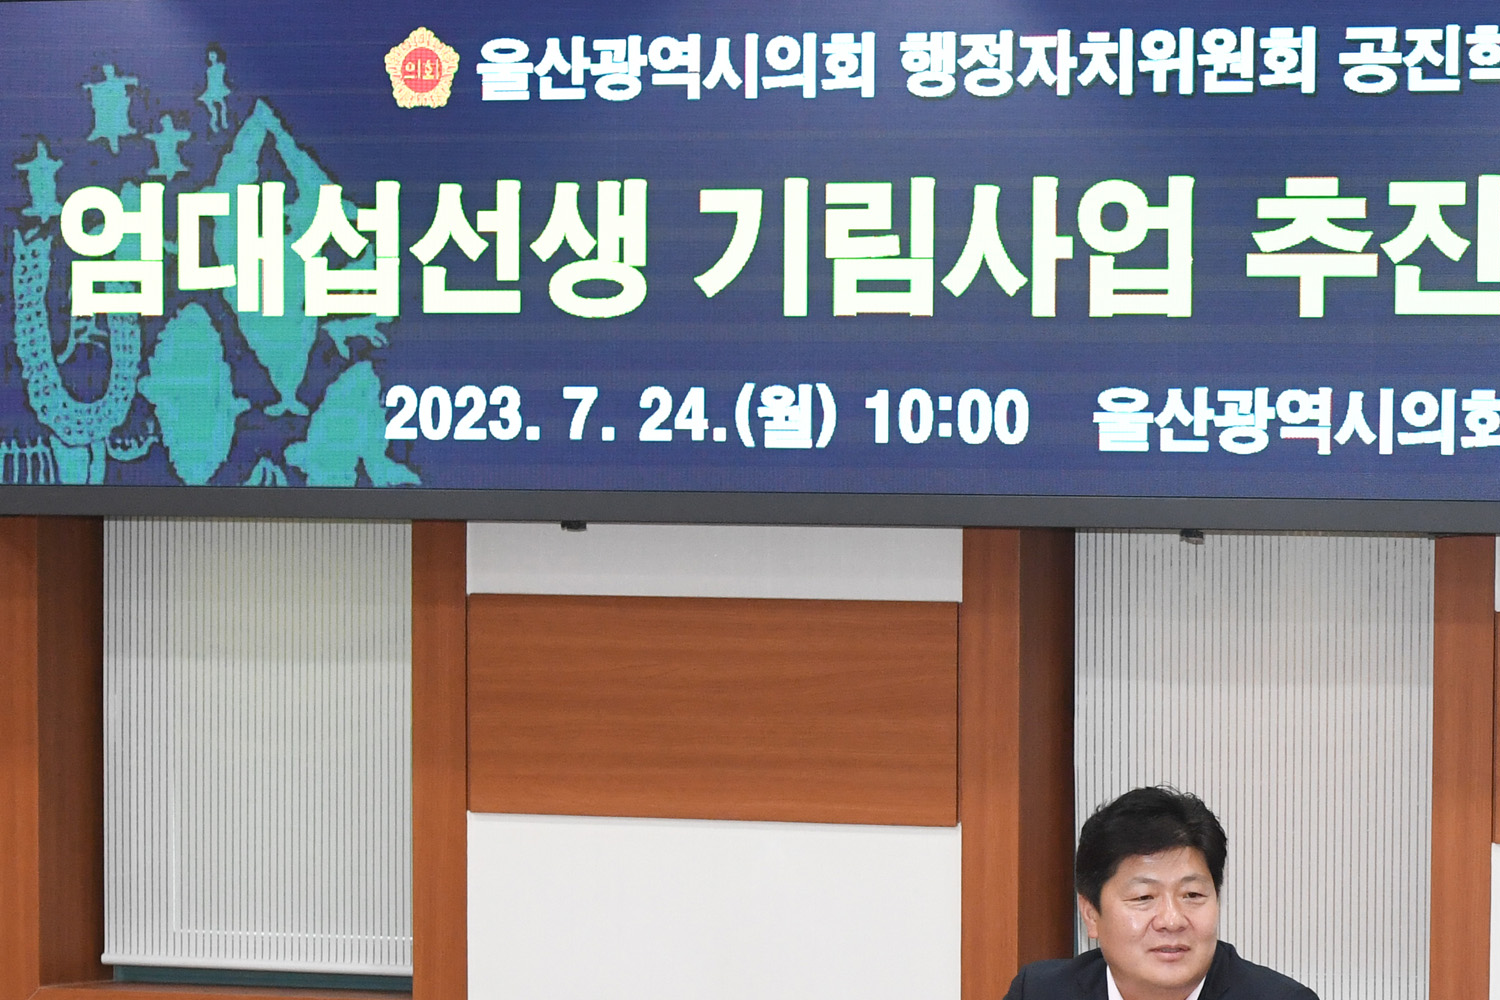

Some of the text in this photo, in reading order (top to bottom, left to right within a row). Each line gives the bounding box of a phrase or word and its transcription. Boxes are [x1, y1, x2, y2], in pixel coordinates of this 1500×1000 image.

[403, 58, 441, 80] 의회
[476, 31, 876, 101] 울산광역시의회
[899, 26, 1317, 98] 행정자치위원회
[60, 178, 648, 318] 엄대섭선생
[693, 175, 1195, 318] 기림사업
[384, 382, 1029, 449] 2023. 7. 24.(월) 10:00
